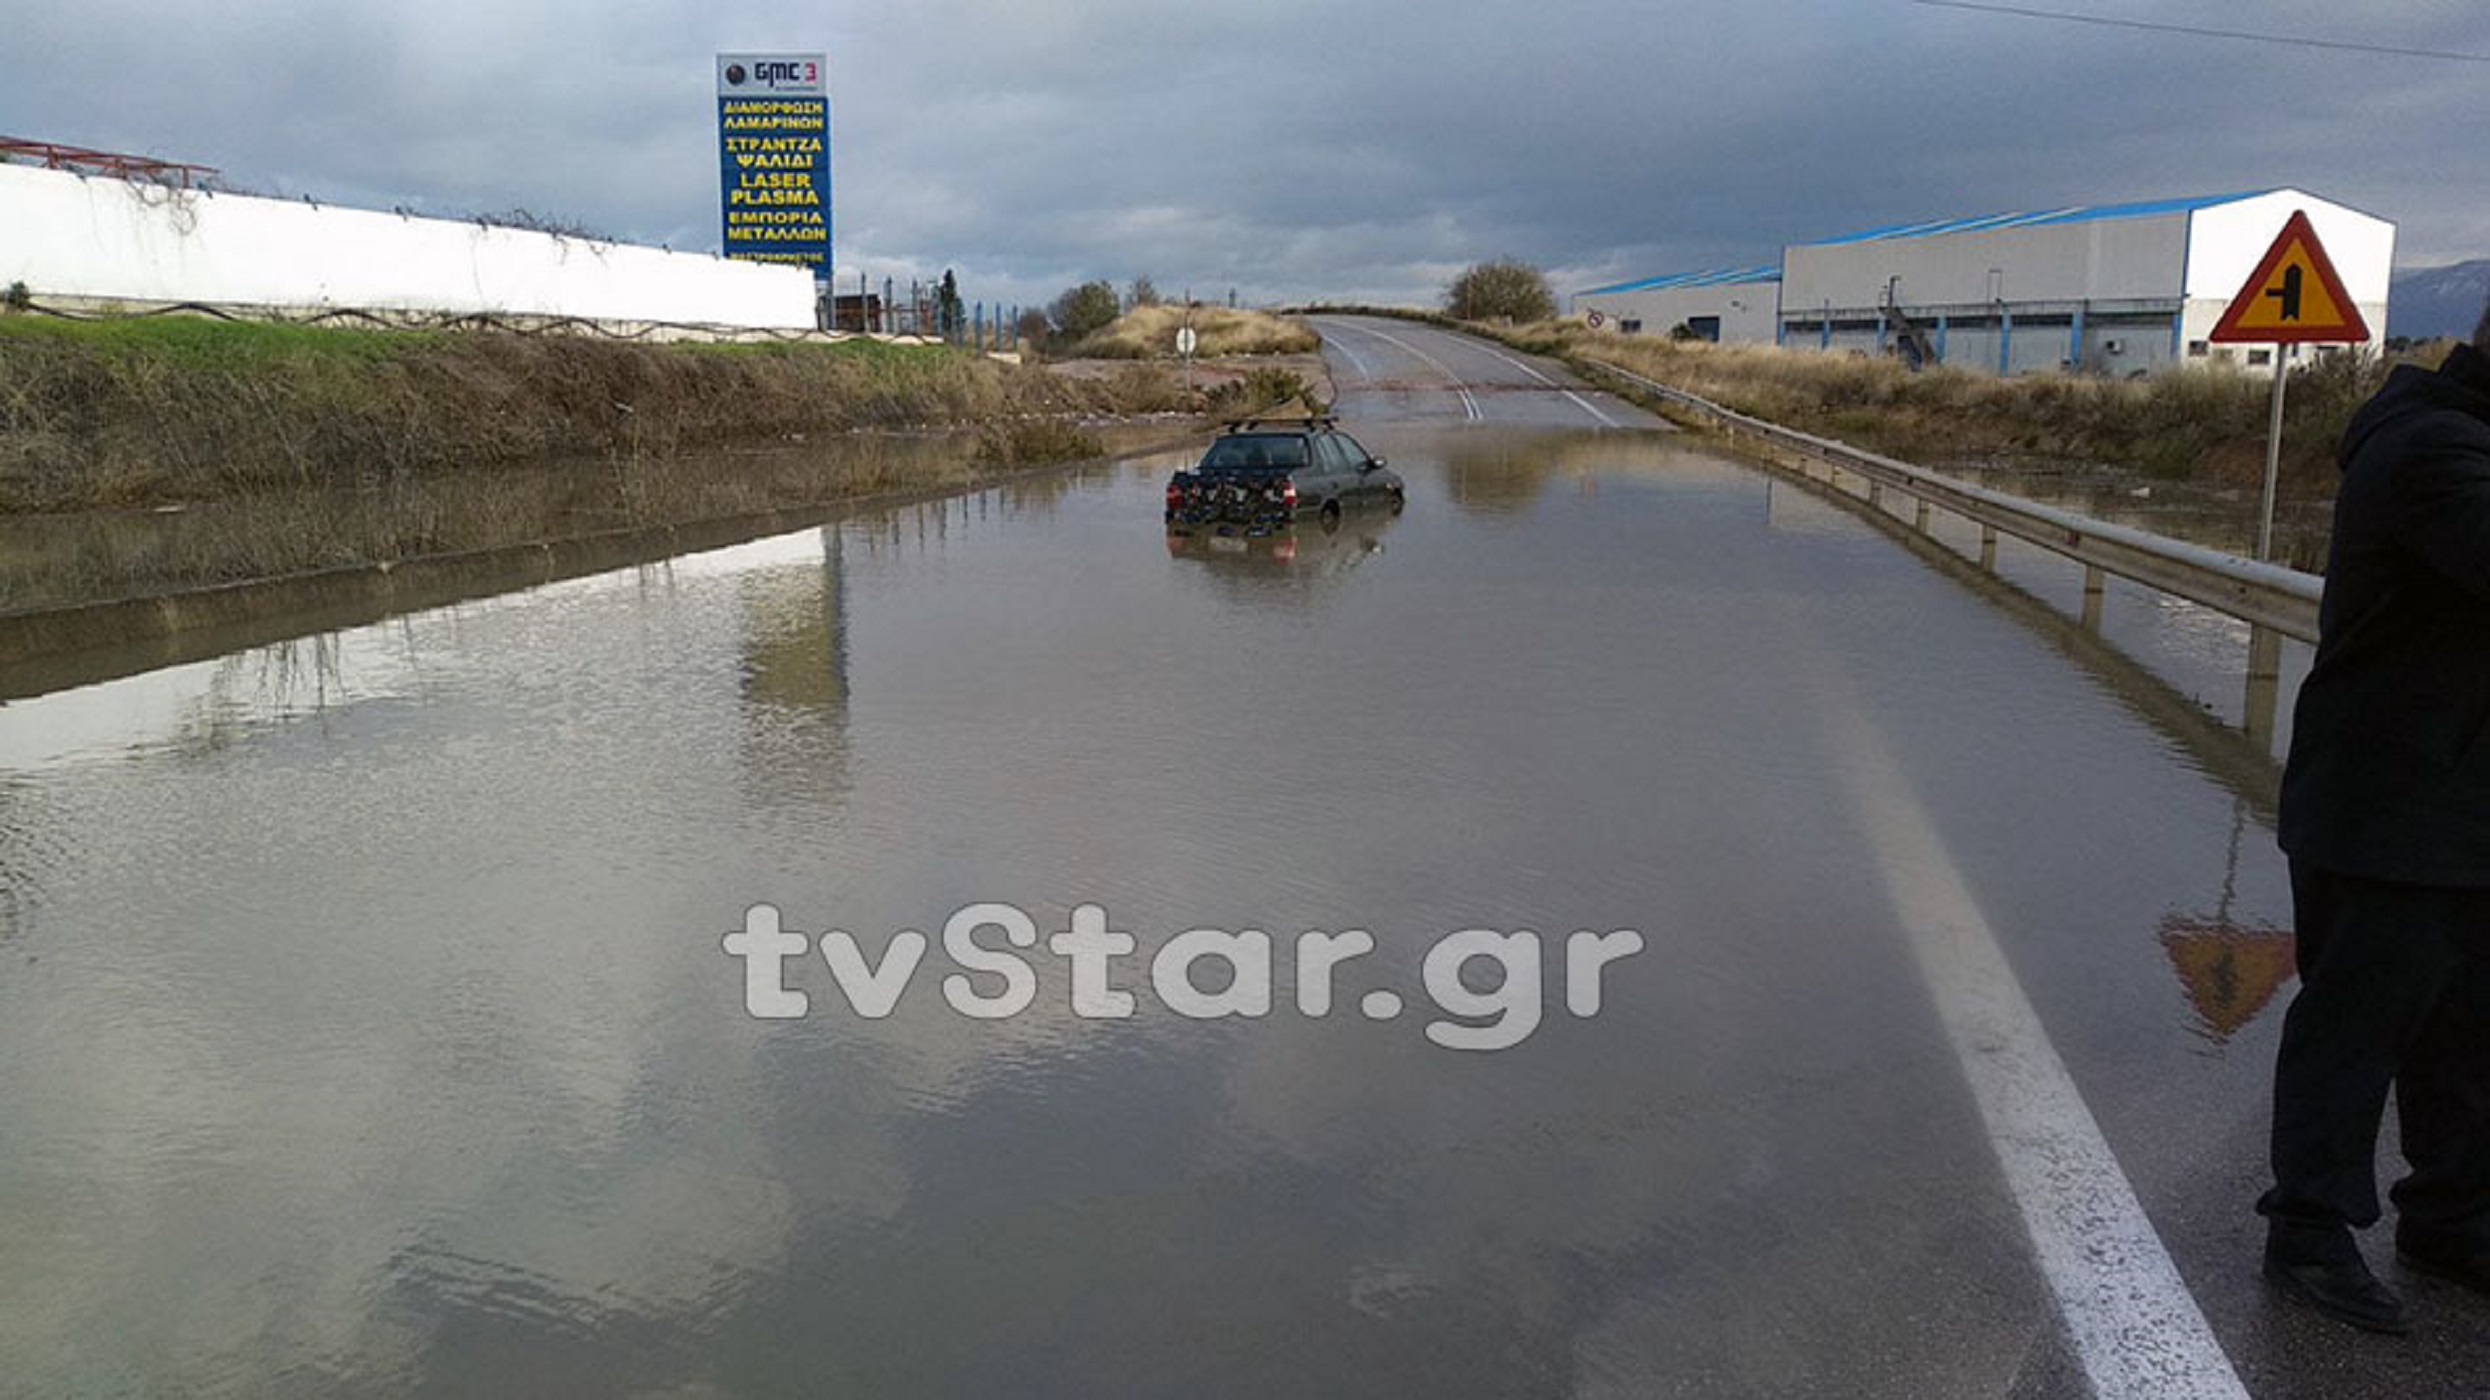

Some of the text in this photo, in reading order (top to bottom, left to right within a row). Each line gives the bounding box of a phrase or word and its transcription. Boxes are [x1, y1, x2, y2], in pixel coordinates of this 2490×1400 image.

[805, 62, 816, 82] 3
[724, 102, 823, 114] ΔΙΑΜΟΡΦΩΣΗ
[724, 117, 823, 129] ΛΑΜΑΡΙΝΩΝ
[727, 138, 821, 151] ΣΤΡΑΝΤΖΑ
[737, 154, 813, 168] ΨΑΛΙΔΙ
[741, 173, 811, 188] LASER
[731, 190, 819, 205] PLASMA
[729, 212, 822, 224] ΕΜΠΟΡΙΑ
[728, 227, 826, 240] ΜΕΤΑΛΛΩΝ
